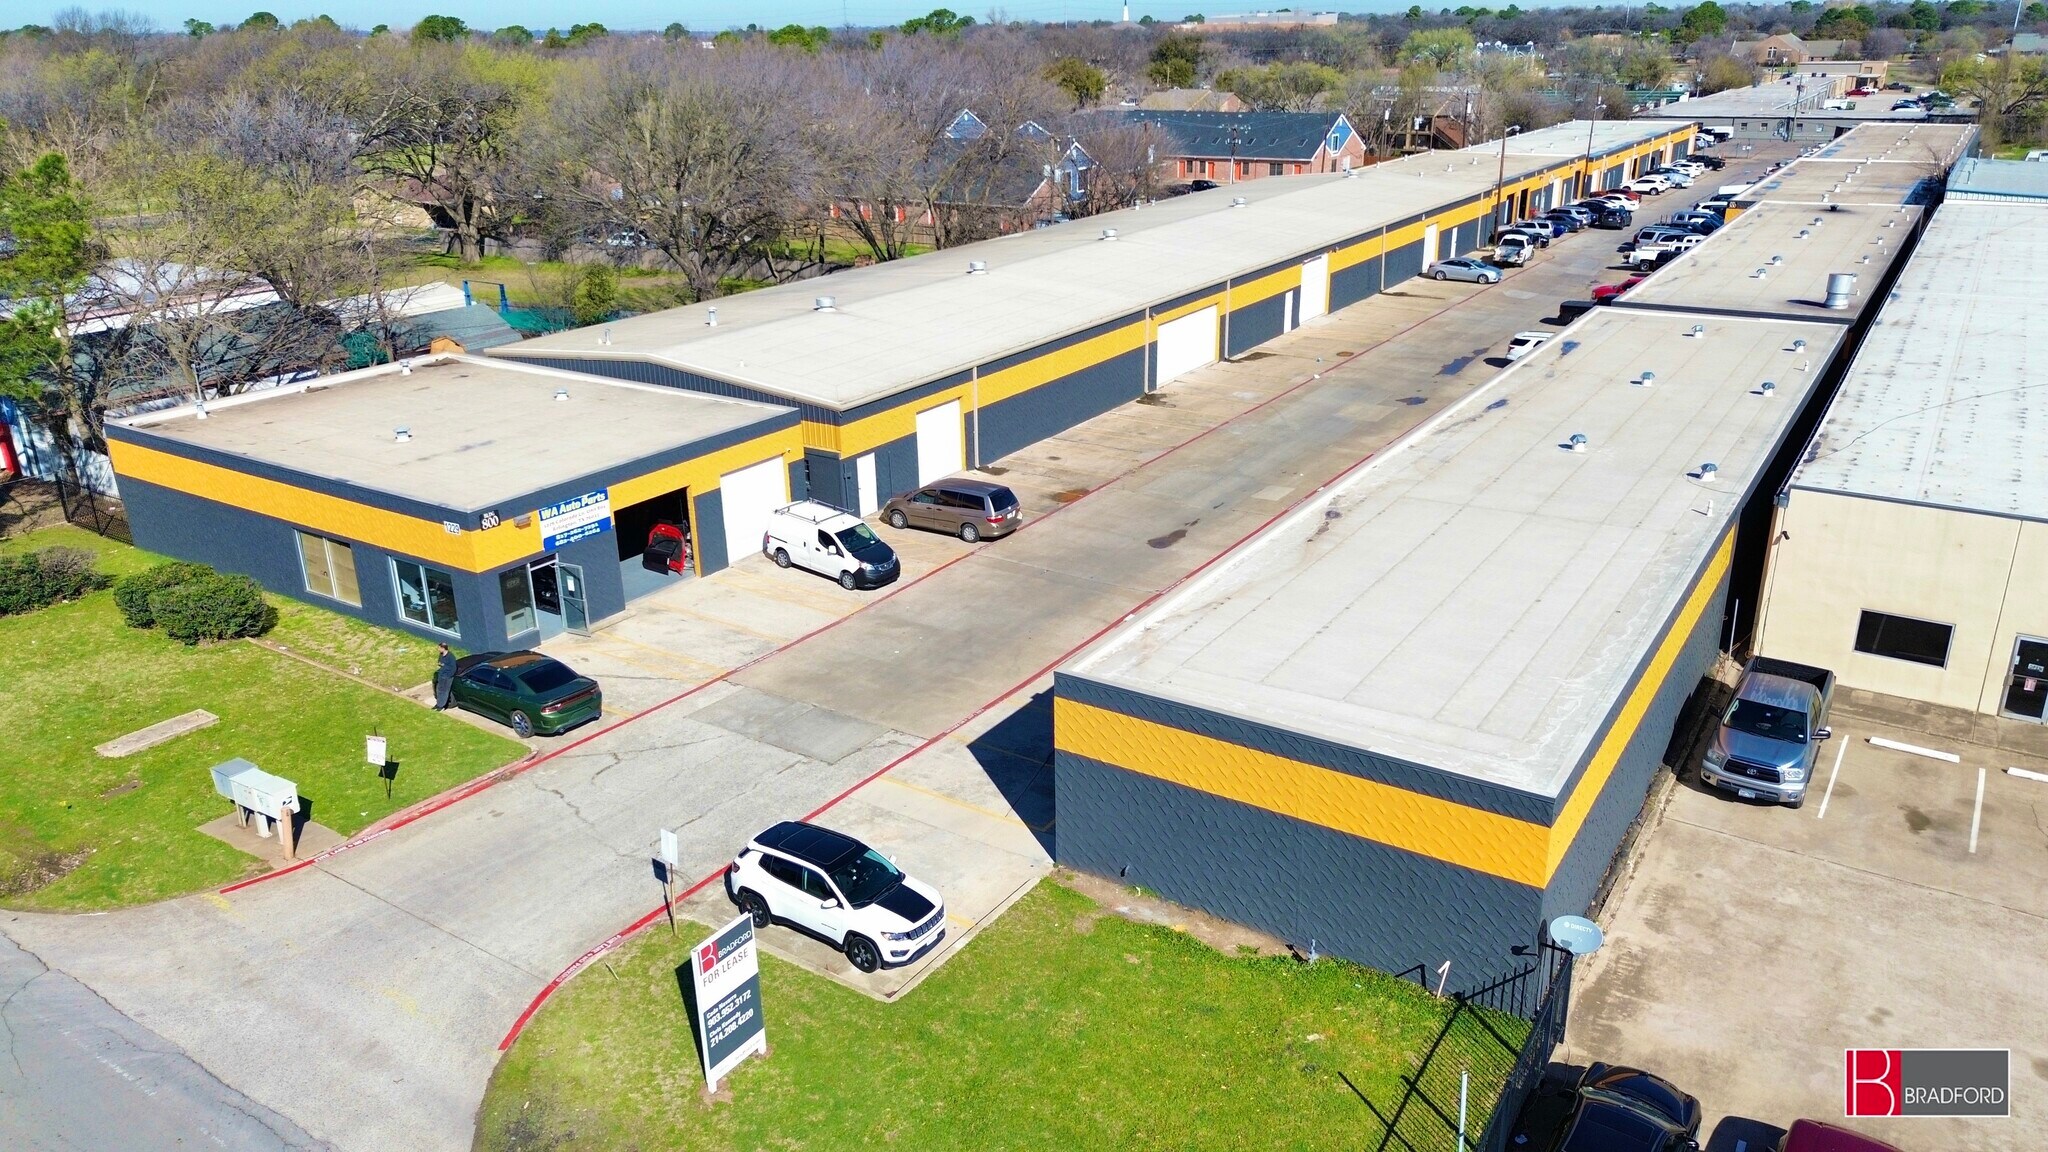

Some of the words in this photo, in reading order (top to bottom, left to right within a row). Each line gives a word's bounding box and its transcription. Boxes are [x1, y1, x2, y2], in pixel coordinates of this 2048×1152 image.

[541, 506, 559, 520] WA
[559, 501, 581, 515] Auto
[581, 493, 606, 507] Parts
[481, 515, 499, 530] 800
[1570, 923, 1593, 933] DIRECTV
[717, 930, 752, 958] BRADFORD
[703, 968, 720, 988] FOR
[722, 947, 749, 974] LEASE
[707, 989, 752, 1028] 903.952.3172
